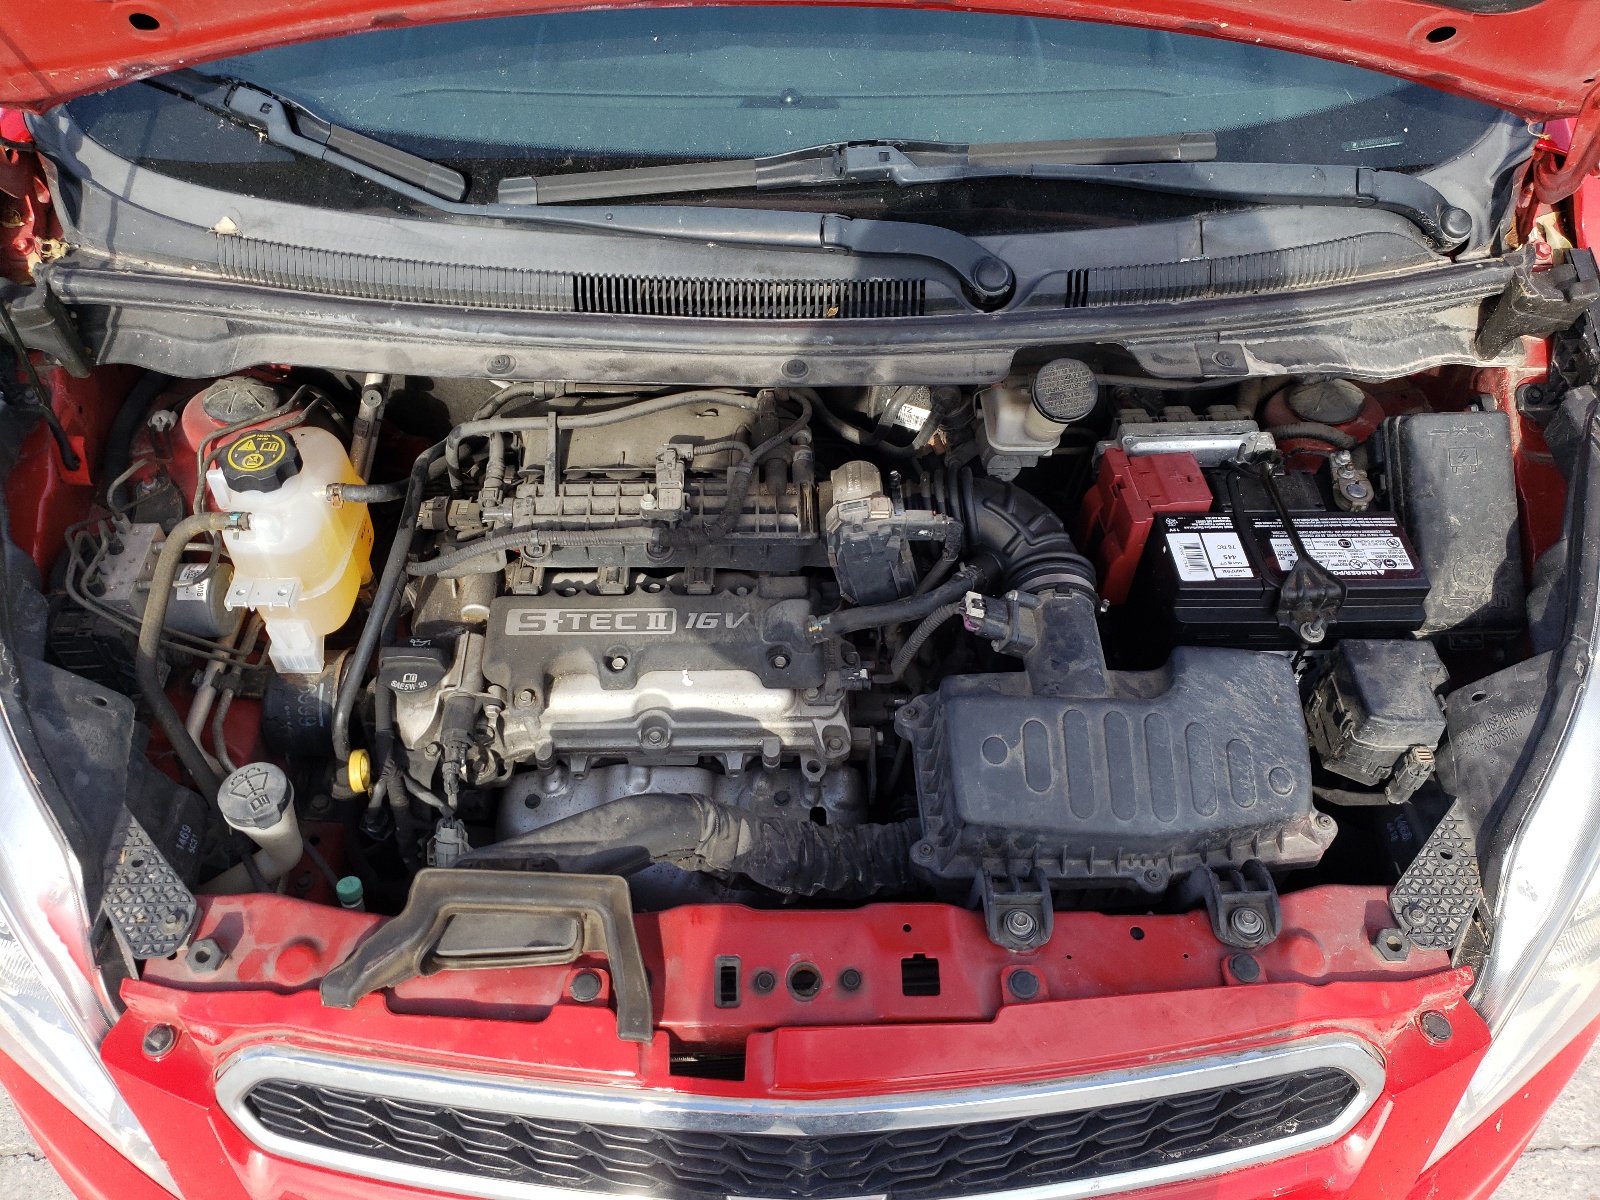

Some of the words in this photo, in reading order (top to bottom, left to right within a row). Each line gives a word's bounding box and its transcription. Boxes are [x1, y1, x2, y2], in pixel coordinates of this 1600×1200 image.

[685, 612, 751, 629] 16V
[1482, 713, 1500, 732] USE
[1498, 707, 1518, 726] THIS
[175, 824, 192, 850] 1469
